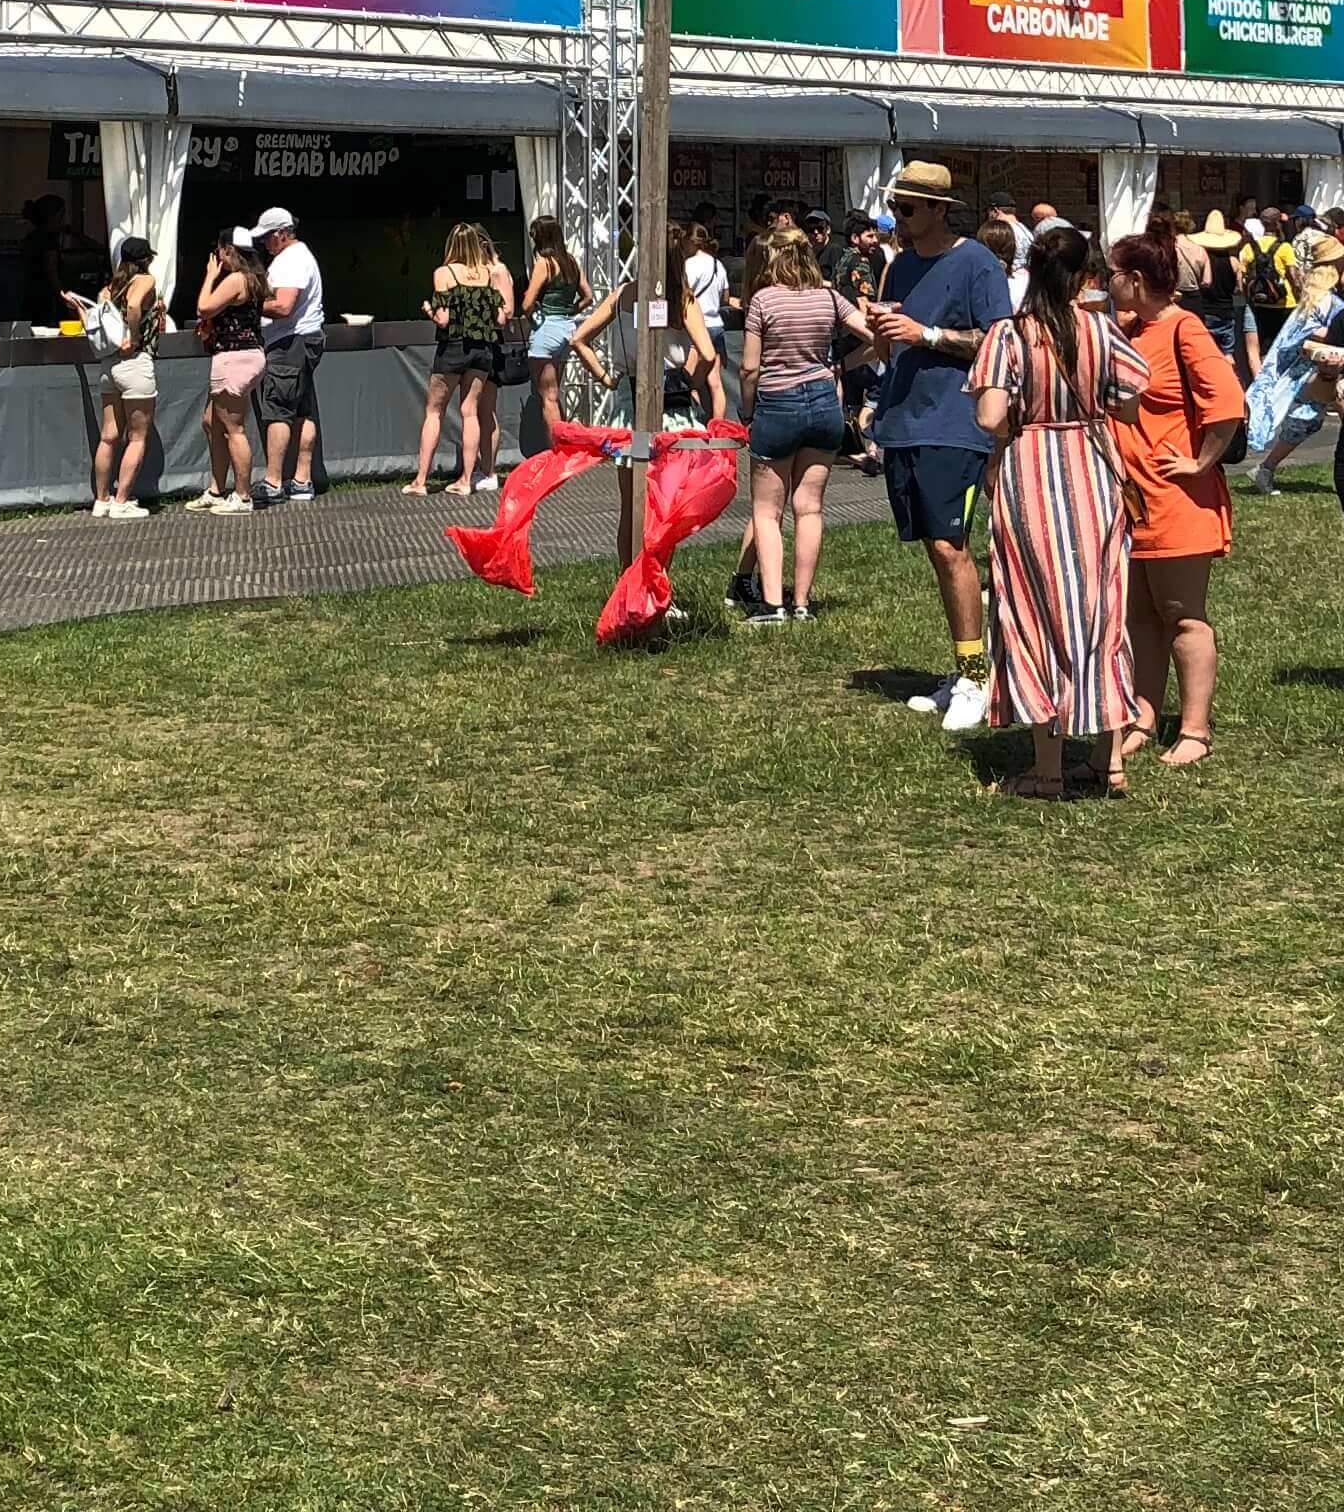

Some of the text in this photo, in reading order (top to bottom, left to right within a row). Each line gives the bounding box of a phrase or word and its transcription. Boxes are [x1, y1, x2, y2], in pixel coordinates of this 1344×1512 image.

[987, 3, 1110, 41] CARBONADE
[1268, 0, 1332, 25] MEXICANO
[1219, 19, 1323, 47] CHICKEN BURGER
[256, 133, 332, 149] GREENWAY'S
[255, 150, 325, 177] KEBAB
[329, 150, 388, 177] WRAP
[673, 169, 706, 186] OPEN
[763, 169, 796, 187] OPEN
